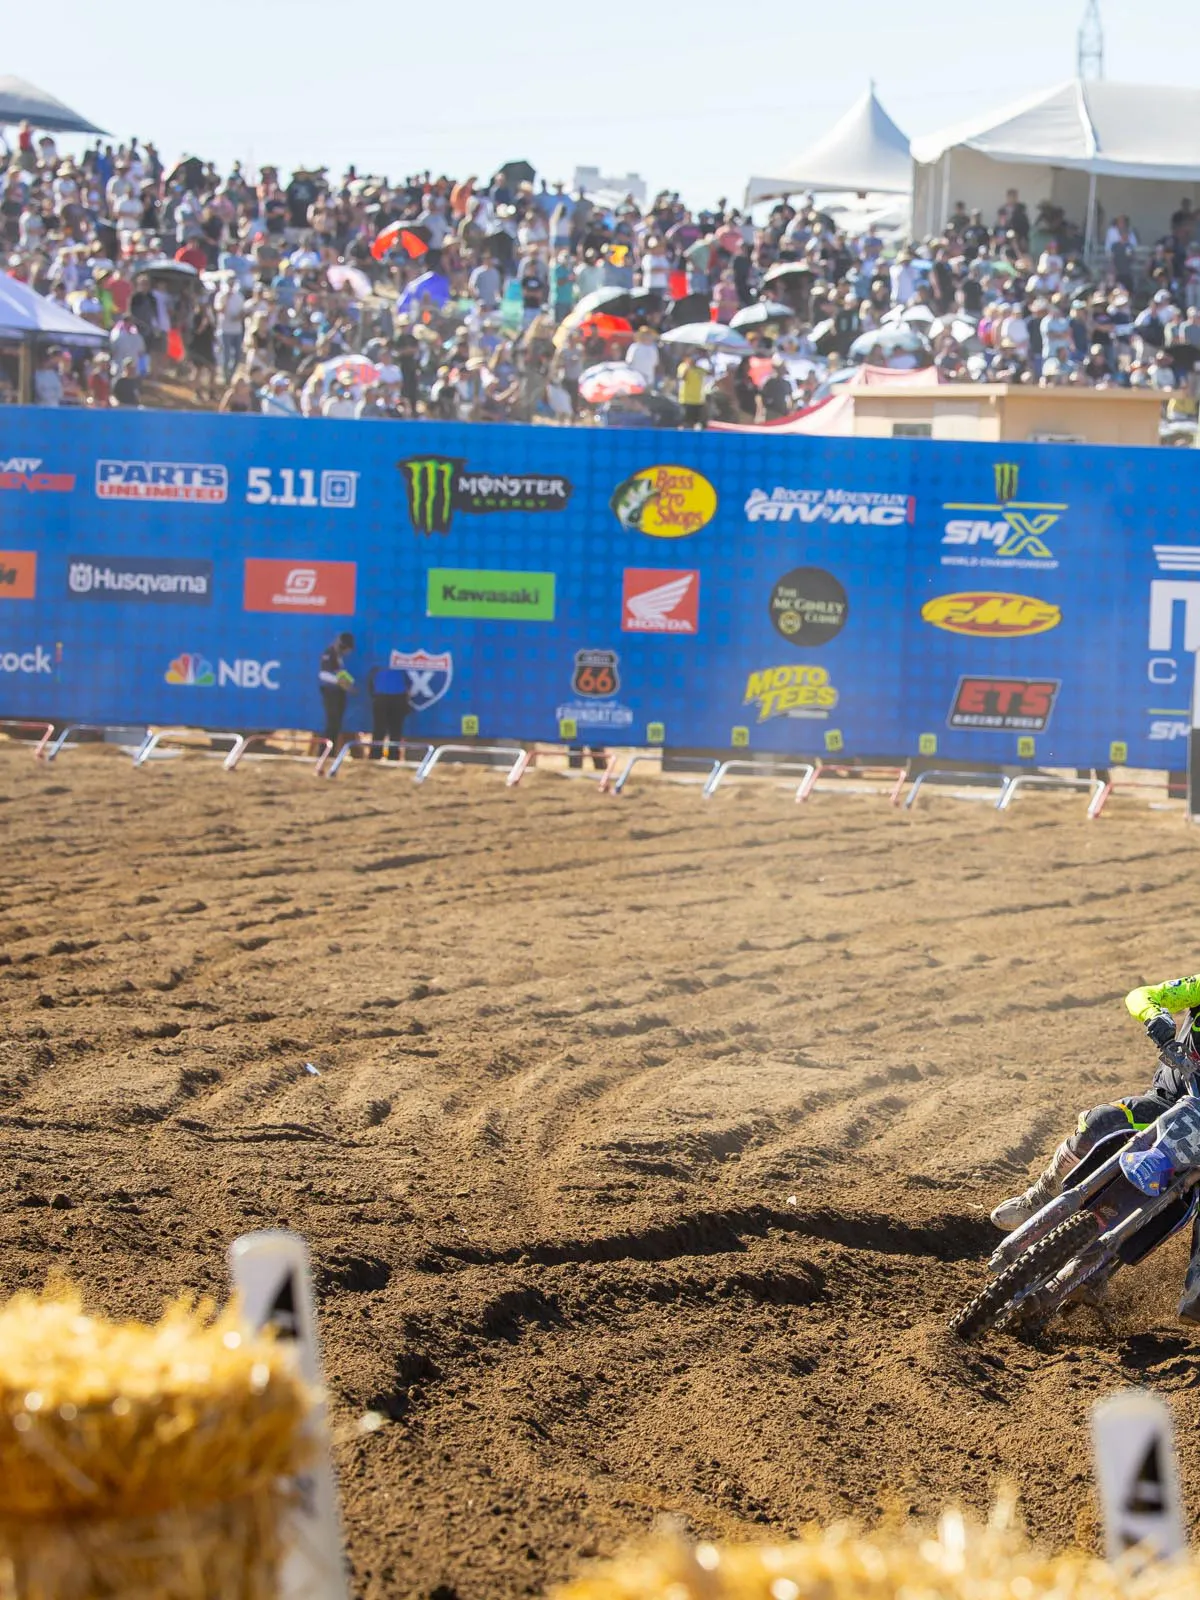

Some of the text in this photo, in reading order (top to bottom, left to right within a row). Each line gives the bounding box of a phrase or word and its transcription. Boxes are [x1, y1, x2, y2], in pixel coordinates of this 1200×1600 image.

[100, 463, 225, 486] PARTS
[246, 467, 319, 507] 5.11
[459, 475, 565, 497] MONSTER
[656, 469, 694, 490] Bass
[98, 484, 225, 499] UNLIMITED
[656, 490, 685, 512] Pro
[653, 510, 705, 530] Shops
[942, 512, 1059, 558] SMX
[93, 567, 208, 595] Husqvarna
[442, 584, 540, 606] Kawasaki
[626, 616, 693, 632] HONDA
[921, 598, 1061, 628] FMF
[0, 645, 52, 673] ock
[218, 659, 281, 690] NBC
[577, 666, 613, 692] 66
[744, 665, 829, 702] MOTO
[758, 686, 838, 720] TEES
[958, 681, 1053, 715] ETS
[1149, 722, 1190, 741] SM
